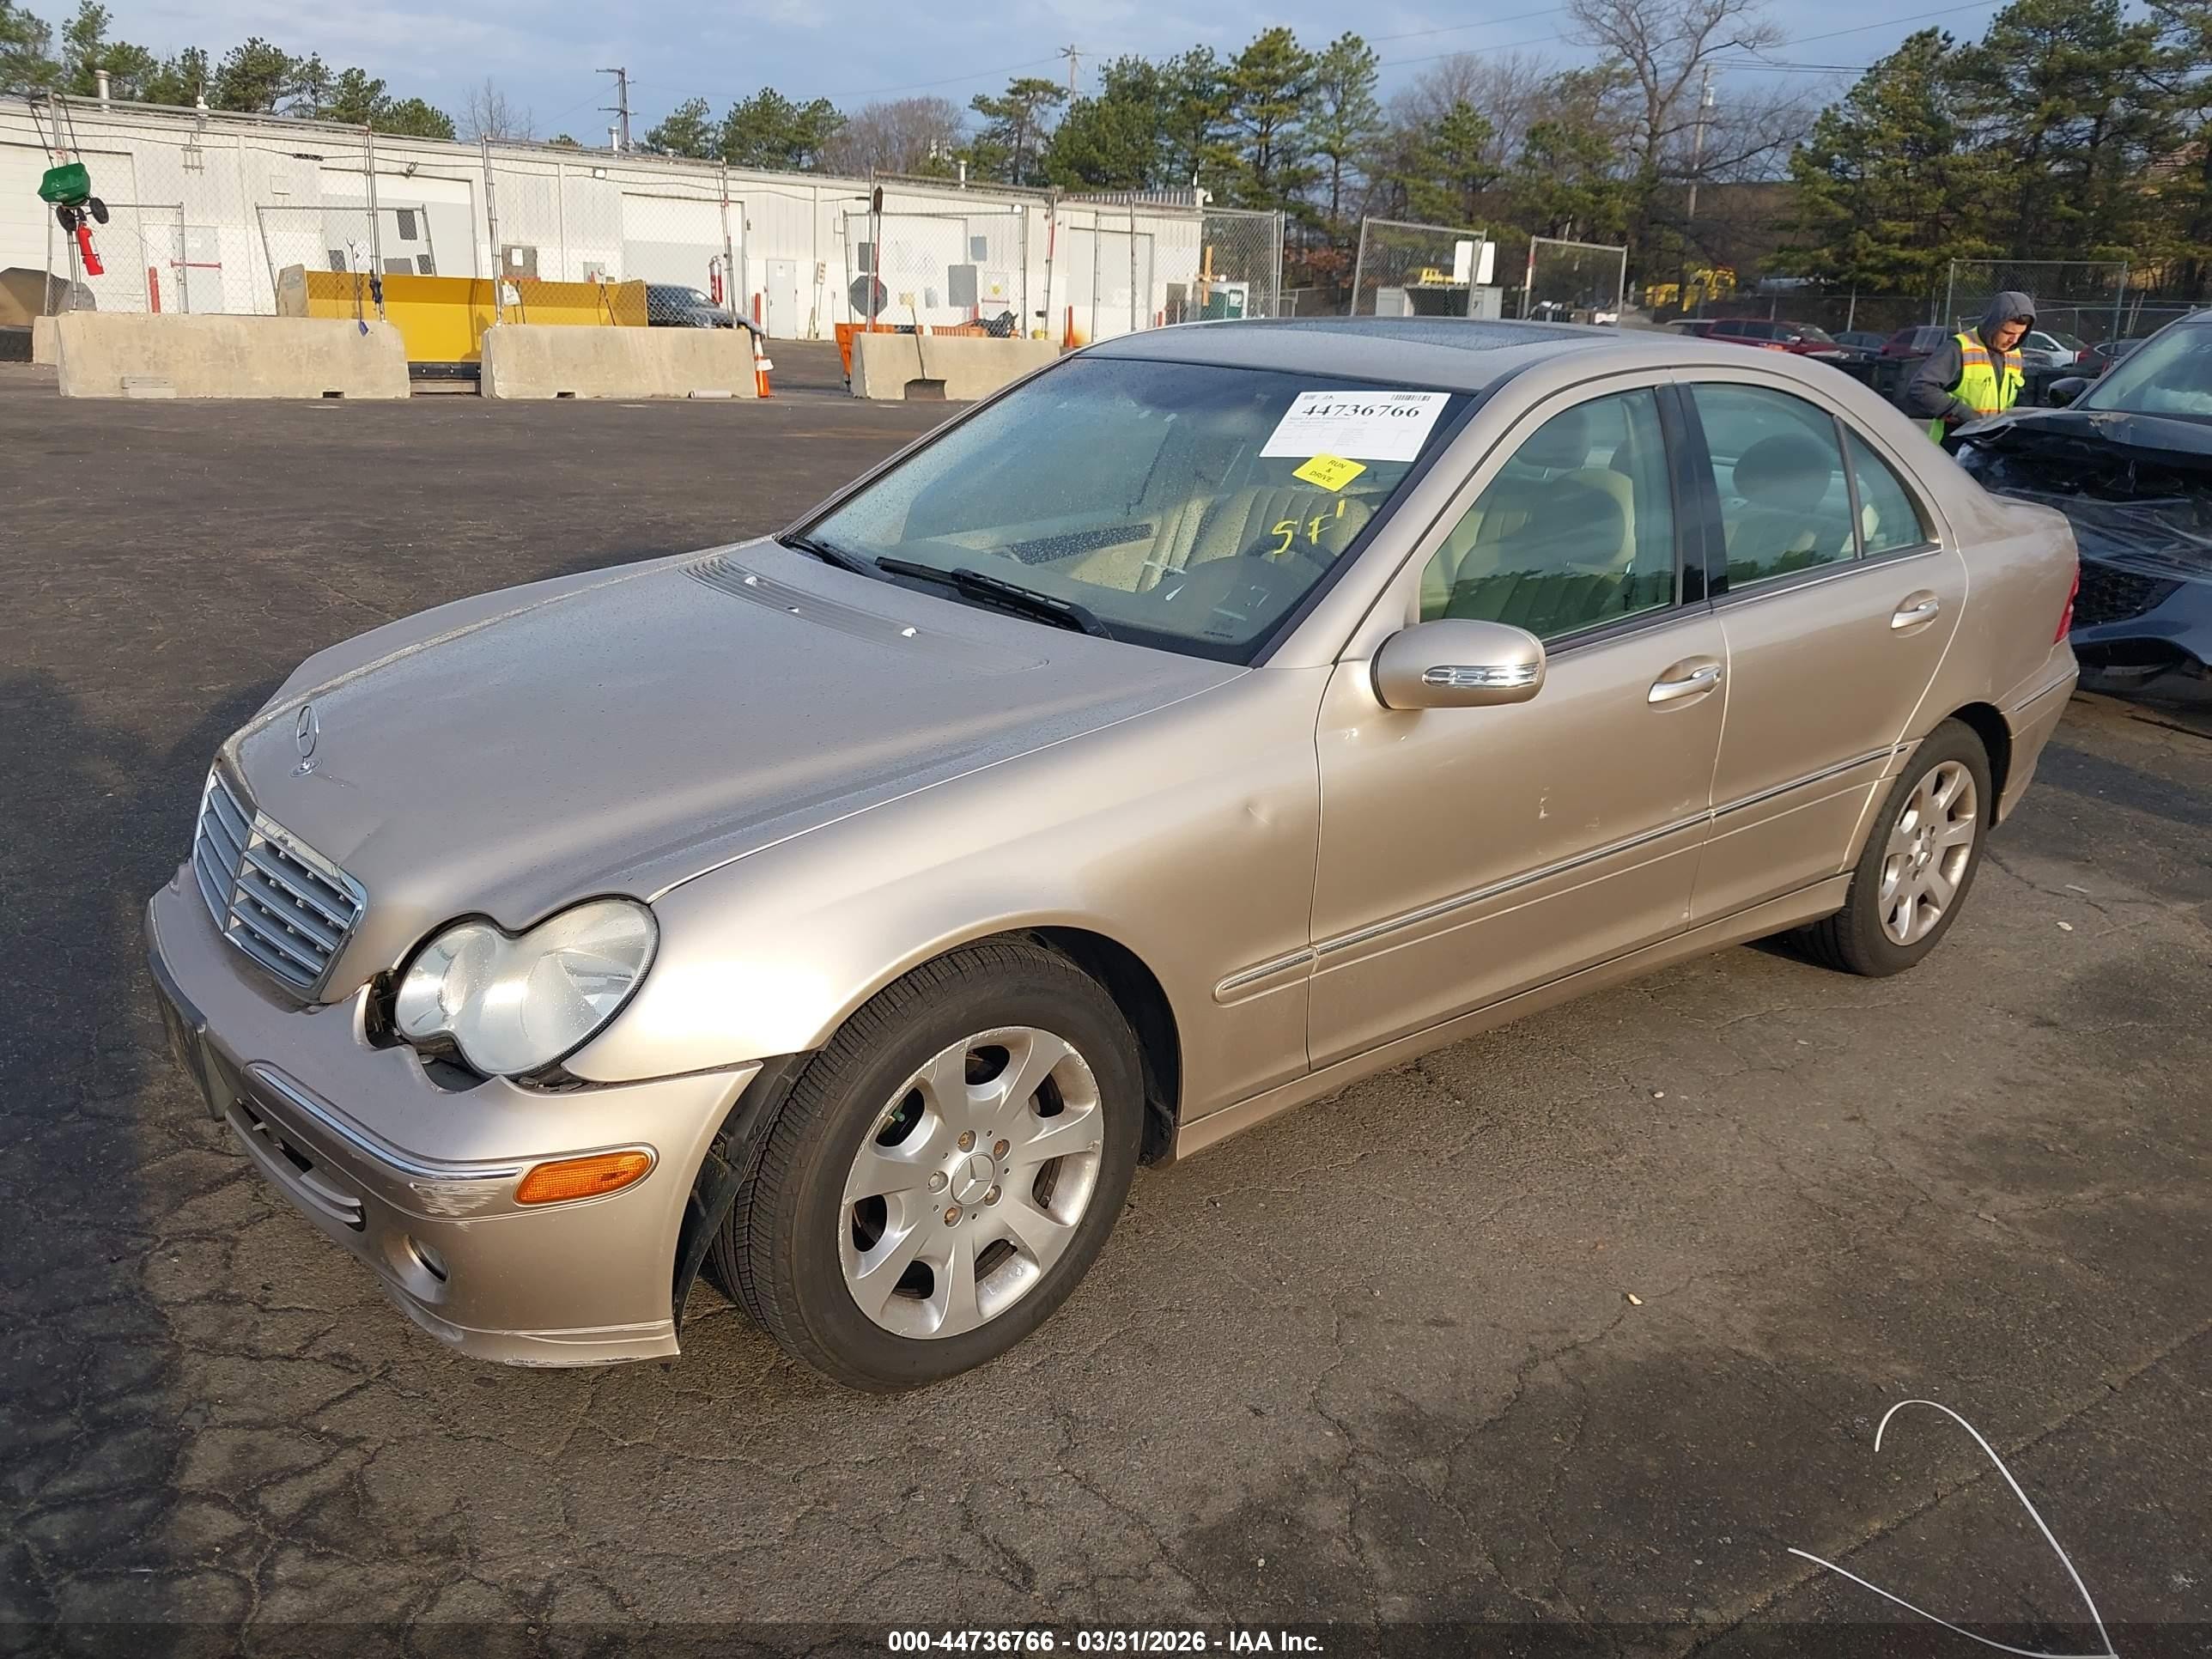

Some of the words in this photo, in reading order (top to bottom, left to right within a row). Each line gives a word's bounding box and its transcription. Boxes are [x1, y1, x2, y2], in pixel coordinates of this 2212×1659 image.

[1302, 404, 1422, 417] 44736766
[1328, 459, 1346, 469] RUN
[1309, 470, 1335, 483] DRIVE
